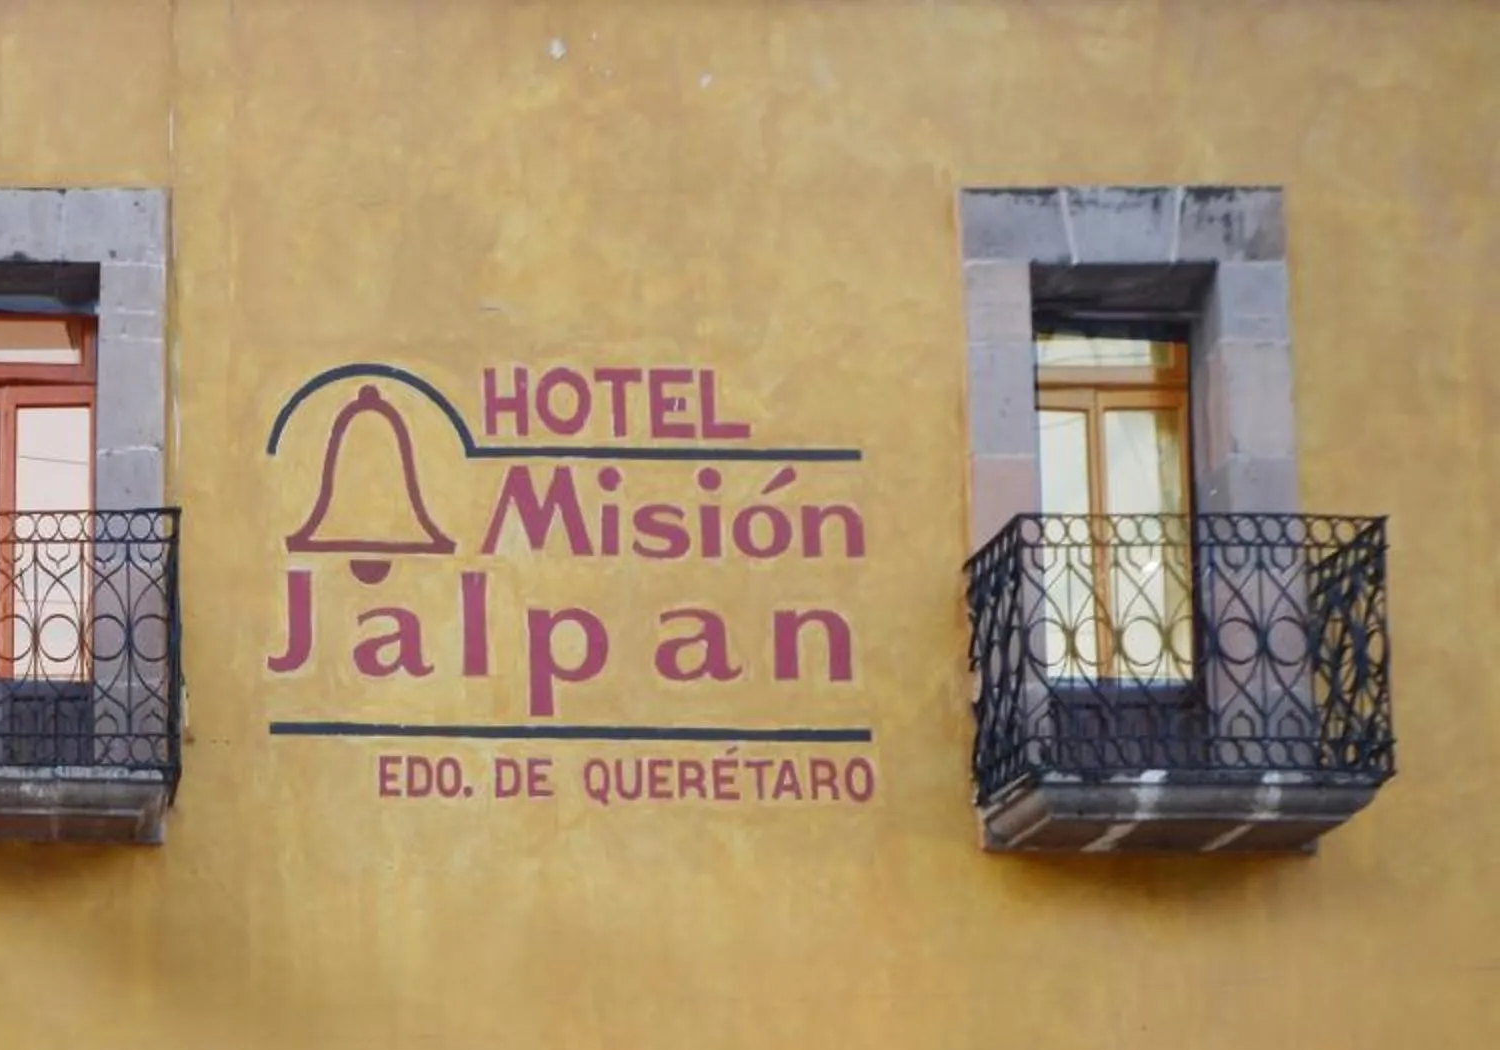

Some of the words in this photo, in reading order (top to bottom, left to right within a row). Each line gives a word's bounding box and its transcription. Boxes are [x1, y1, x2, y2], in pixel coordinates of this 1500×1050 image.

[483, 367, 751, 440] HOTEL
[481, 465, 866, 560] Misión
[267, 570, 853, 717] Jalpan
[377, 756, 474, 799] EDO.
[494, 758, 554, 799] DE
[583, 748, 875, 806] QUERÉTARO
